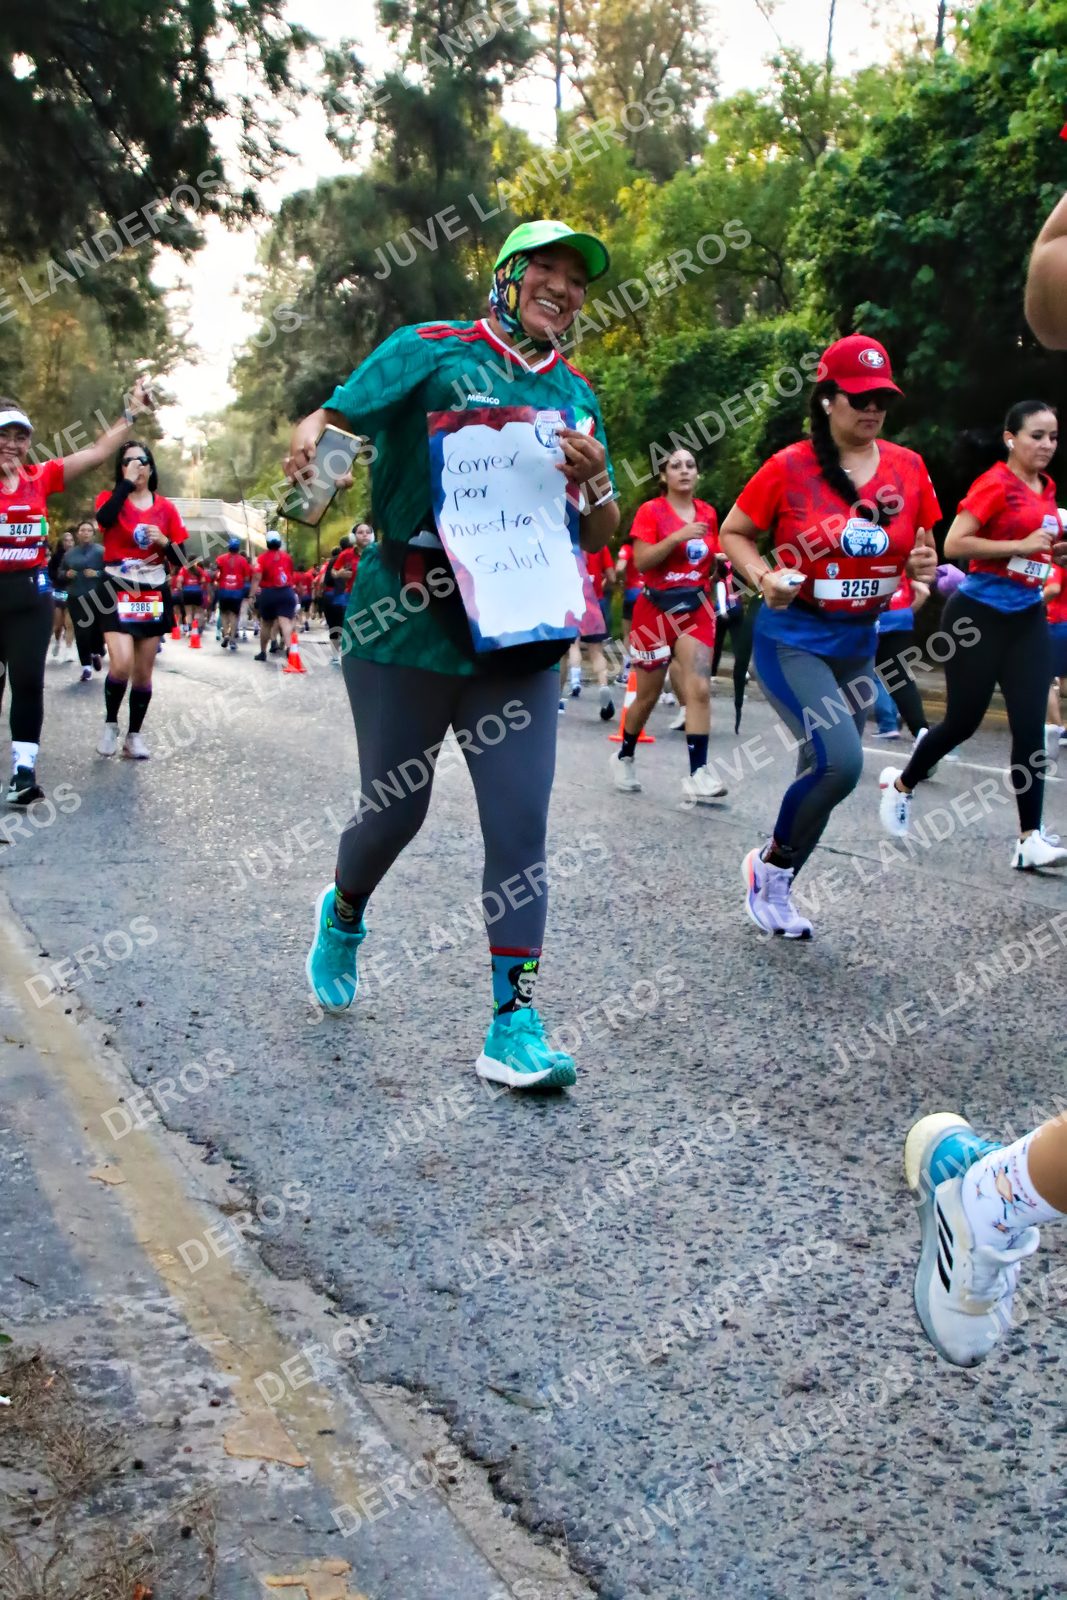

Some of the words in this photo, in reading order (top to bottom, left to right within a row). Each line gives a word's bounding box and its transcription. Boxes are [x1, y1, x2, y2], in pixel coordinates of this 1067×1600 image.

[453, 485, 488, 511] por
[9, 524, 33, 535] 3447
[449, 510, 538, 537] nuestra
[841, 580, 880, 598] 3259
